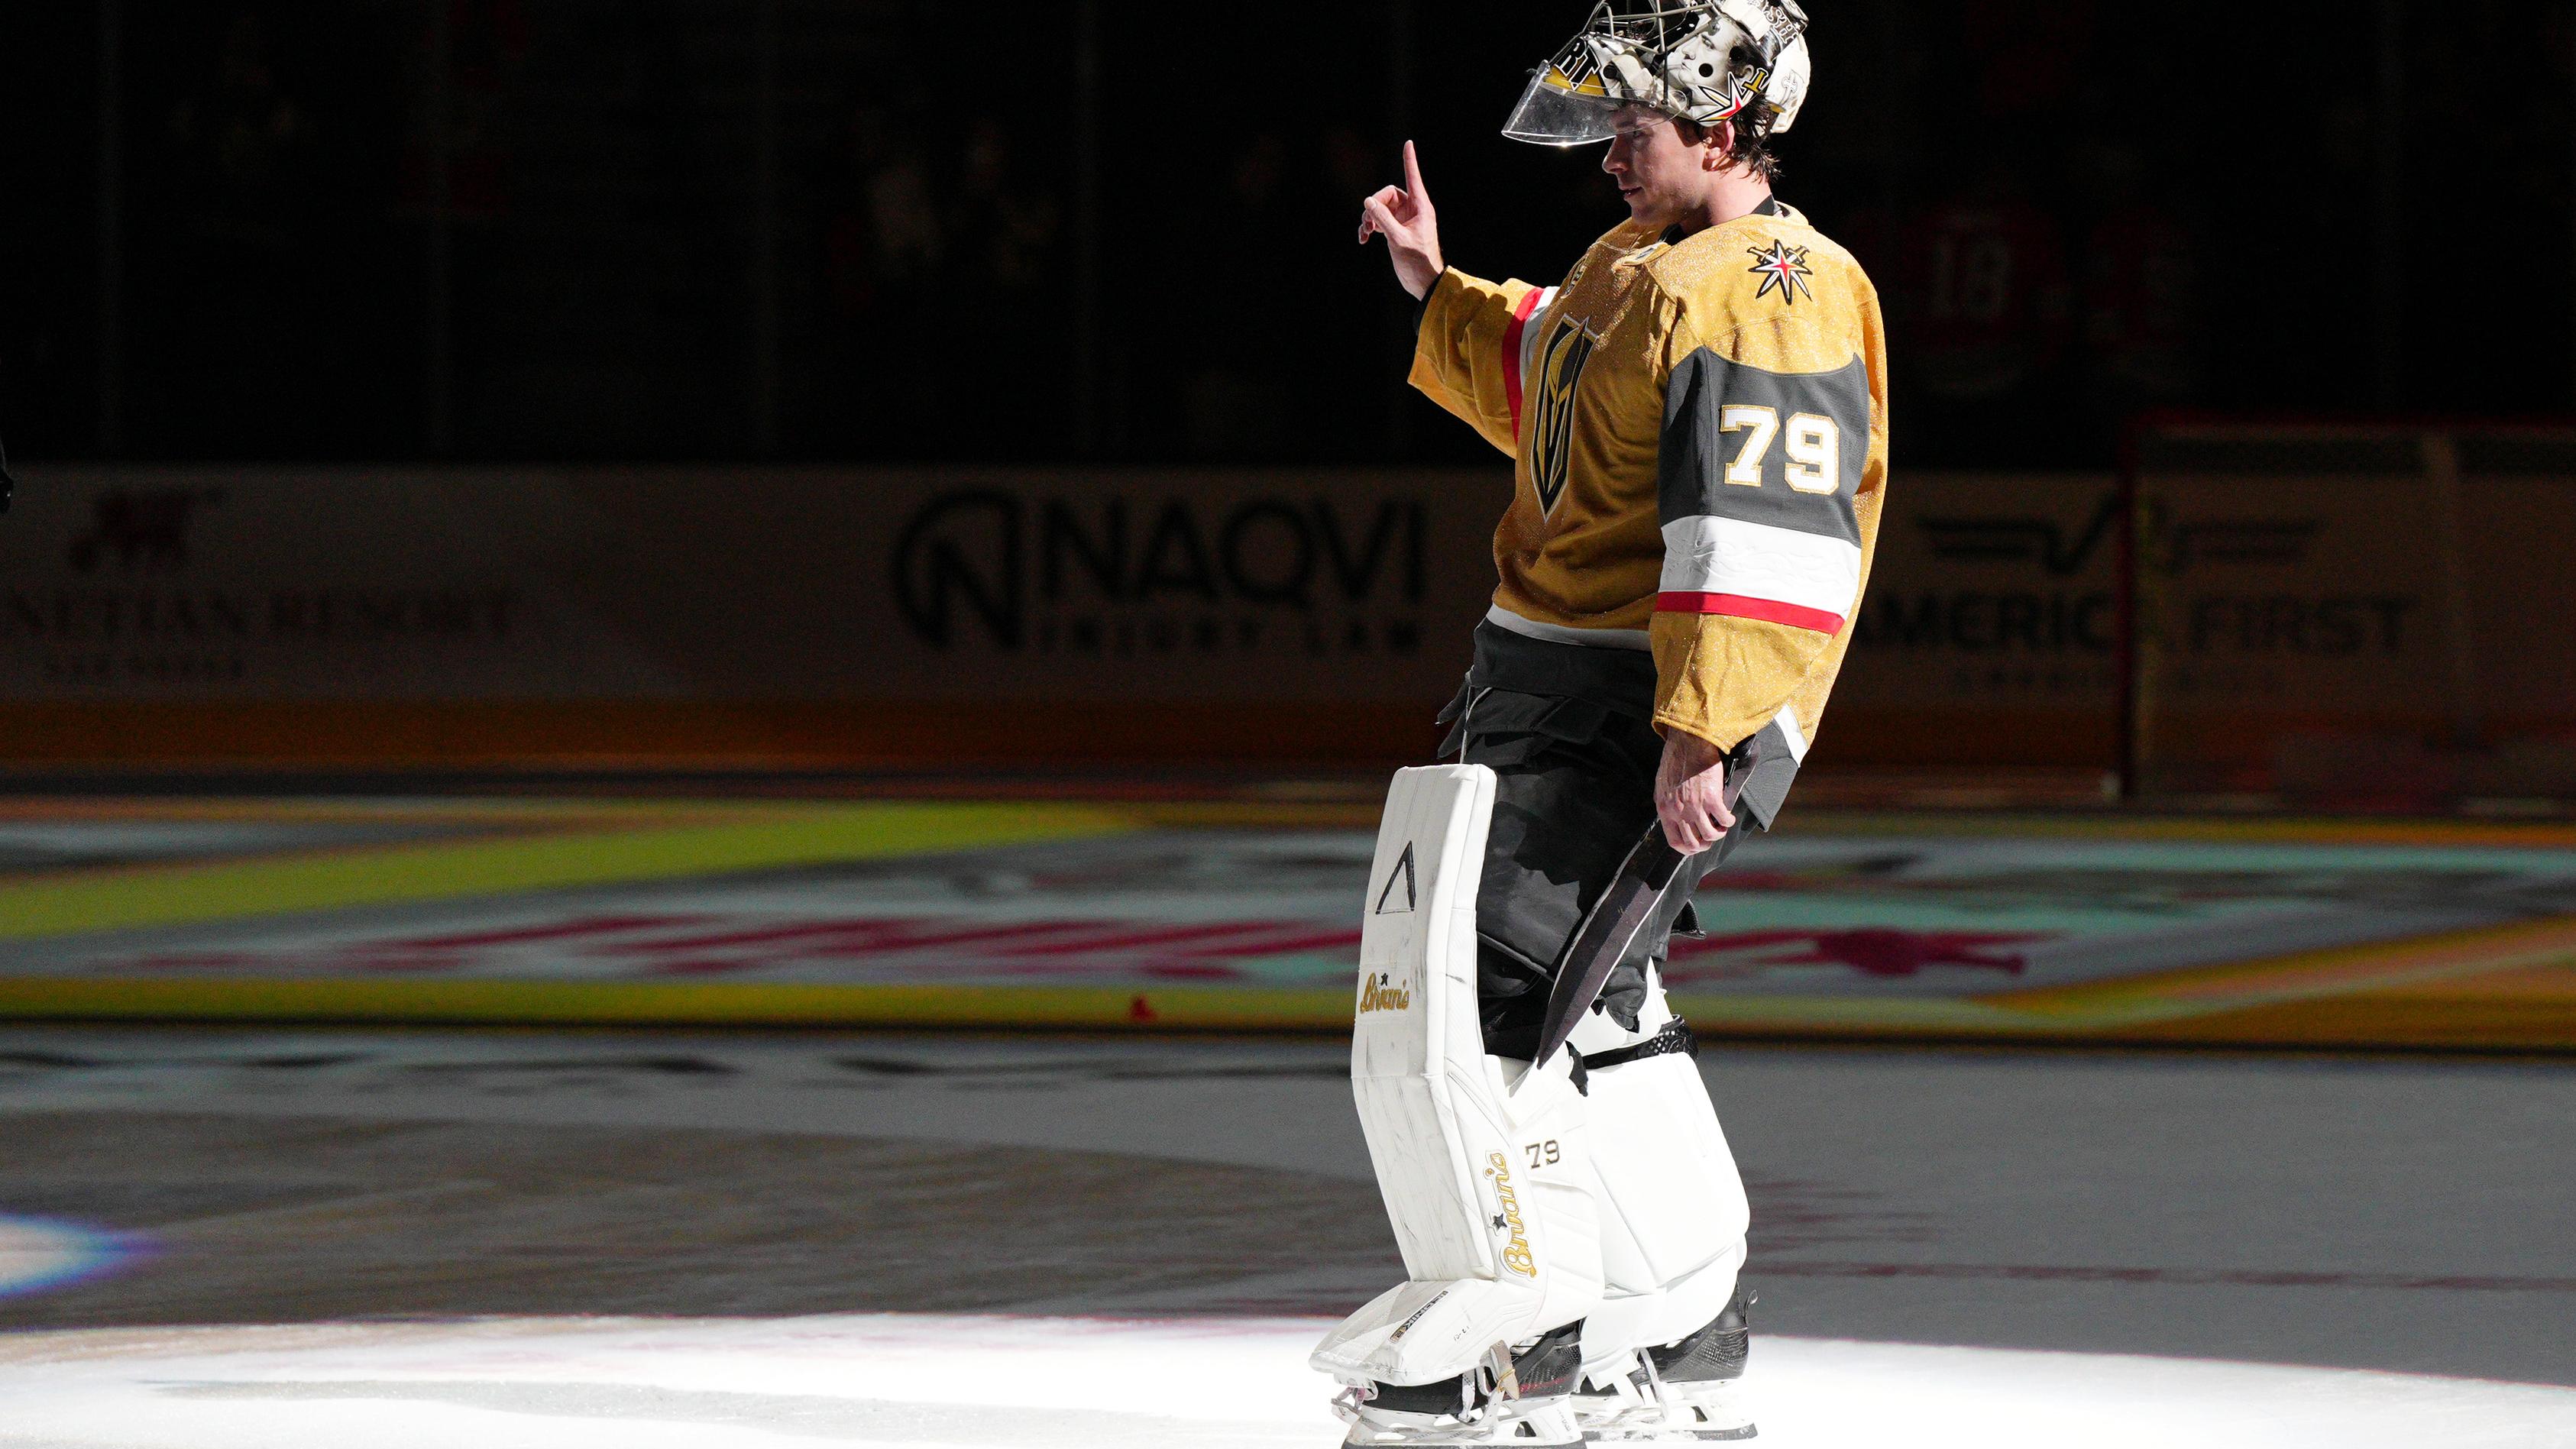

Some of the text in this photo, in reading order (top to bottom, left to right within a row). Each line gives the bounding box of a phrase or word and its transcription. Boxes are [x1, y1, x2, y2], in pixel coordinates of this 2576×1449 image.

[1720, 404, 1840, 496] 79
[1042, 495, 1426, 610] NAQVI
[1855, 592, 2422, 656] MERIC FIRST
[1525, 1139, 1561, 1170] 79
[1485, 1151, 1537, 1279] Brian's
